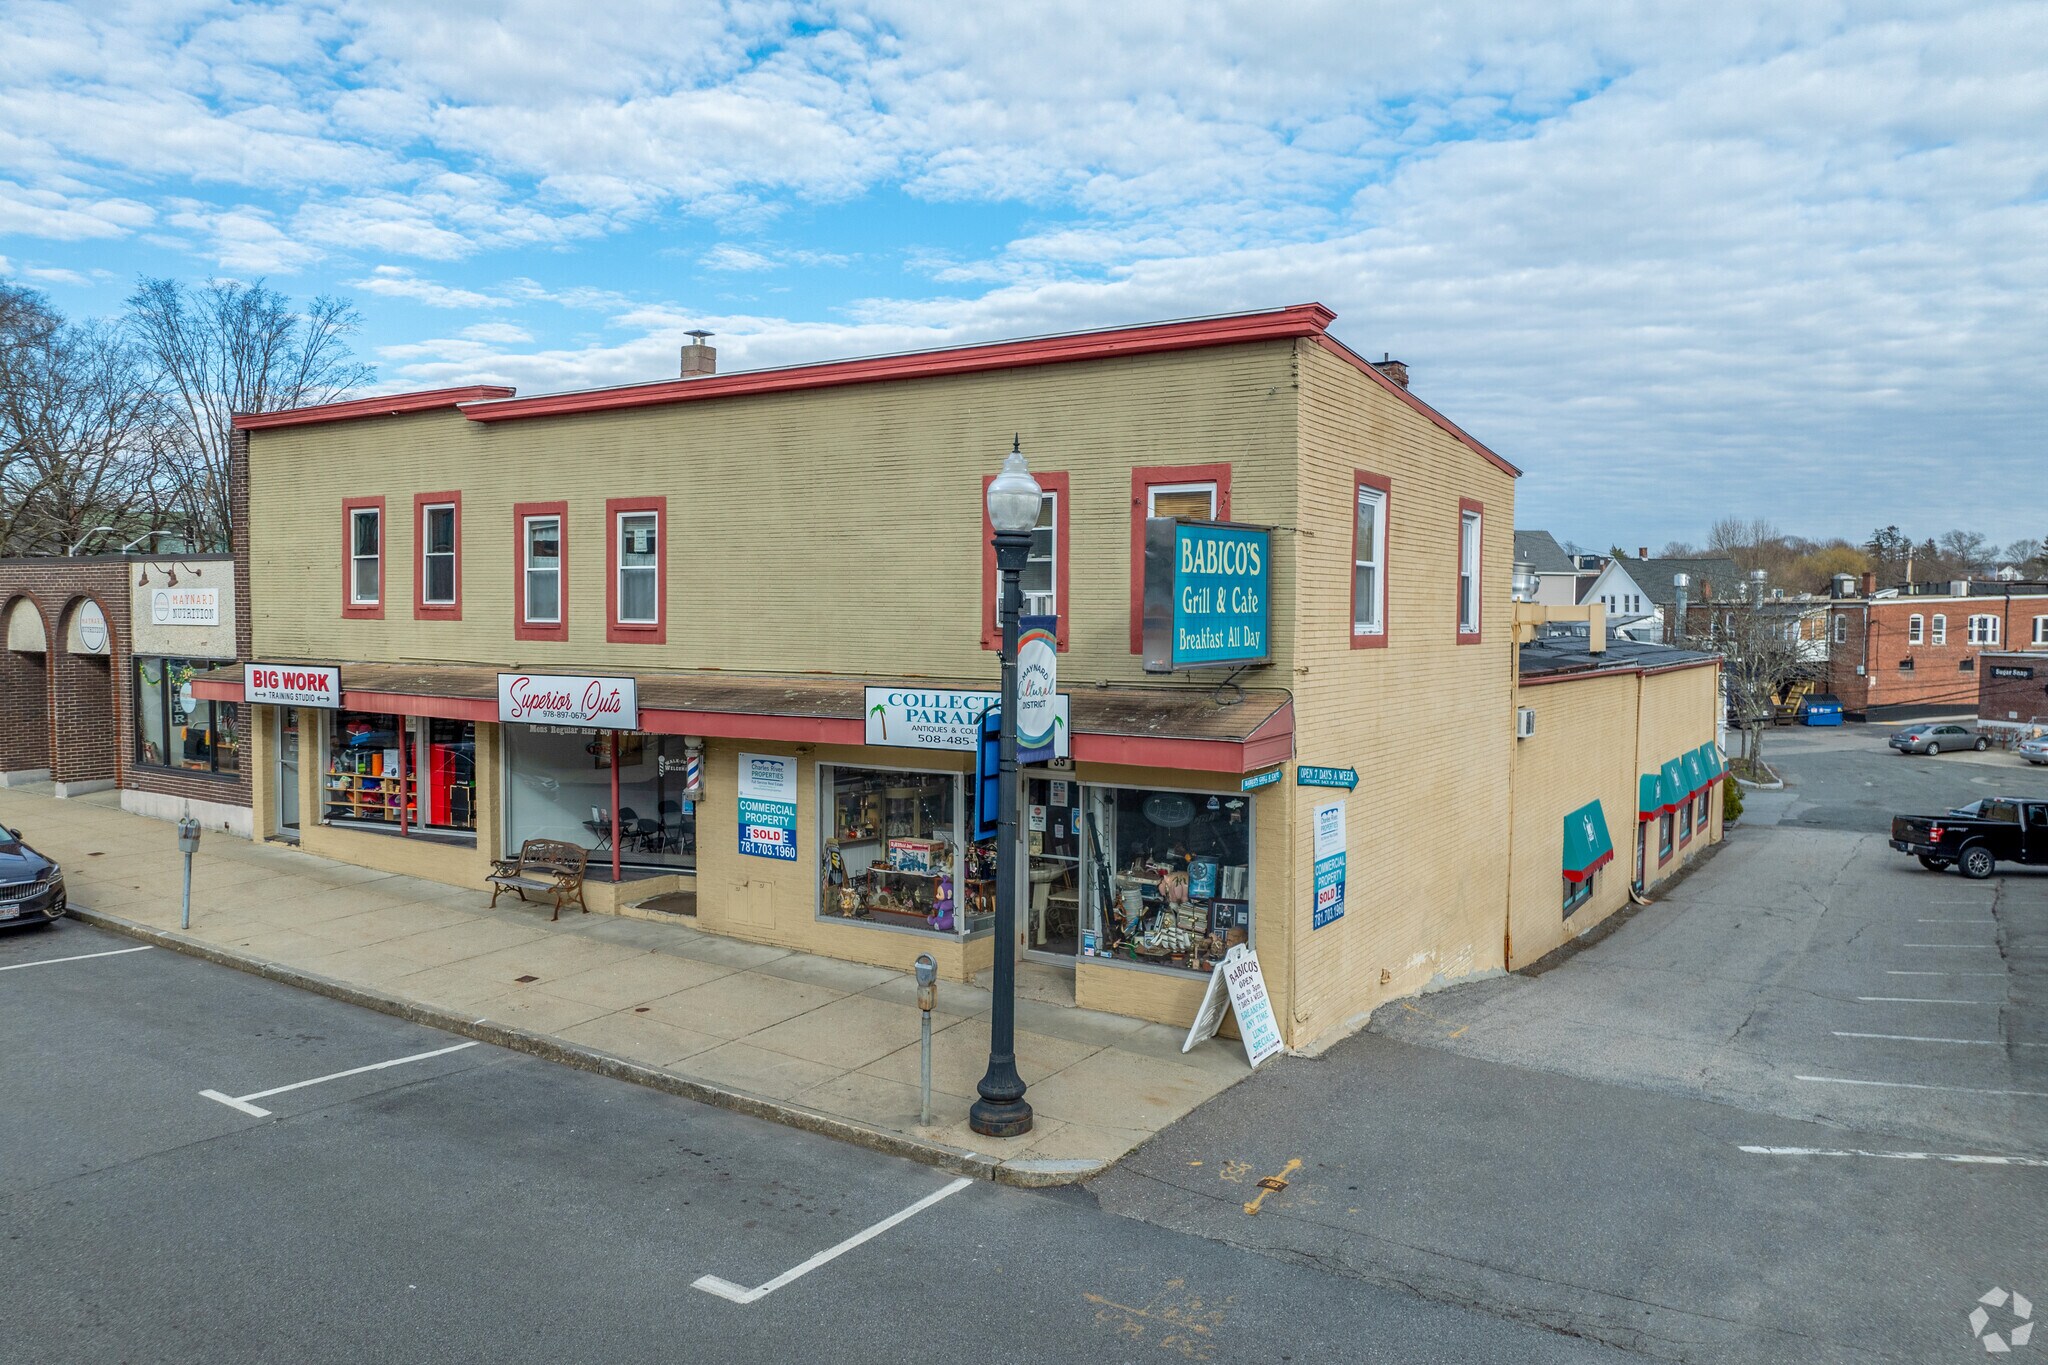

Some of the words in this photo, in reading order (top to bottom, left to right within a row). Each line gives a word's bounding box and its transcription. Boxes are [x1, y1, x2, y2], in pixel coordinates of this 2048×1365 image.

[1181, 538, 1261, 576] BABICO'S
[172, 594, 214, 605] MAYNARD
[1182, 586, 1210, 614] Grill
[1216, 586, 1227, 614] &
[1232, 586, 1259, 614] Cafe
[172, 608, 214, 620] NUTRITION
[1179, 627, 1224, 650] Breakfast
[1227, 626, 1240, 648] All
[1243, 625, 1260, 650] Day
[1021, 663, 1049, 681] MAYNARD
[253, 670, 279, 689] BIG
[282, 672, 330, 692] WORK
[268, 691, 294, 700] TRAINING
[295, 693, 316, 702] STUDIO
[510, 677, 573, 718] Superior
[1022, 700, 1047, 709] DISTRICT
[542, 710, 588, 720] 978-897-0679
[550, 725, 578, 736] Regular
[911, 725, 948, 733] ANTIQUES
[752, 771, 784, 780] PROPERTIES
[1300, 768, 1313, 778] OPEN
[1319, 769, 1332, 780] DAYS
[1333, 770, 1338, 781] A
[1339, 771, 1353, 782] WEEK
[740, 800, 795, 816] COMMERCIAL
[745, 812, 789, 826] PROPERTY
[753, 829, 781, 841] SOLD
[741, 841, 796, 858] 781.703.1960
[1315, 856, 1345, 876] COMMERCIAL
[1318, 869, 1342, 889] PROPERTY
[1319, 888, 1335, 905] SOLD
[1229, 960, 1258, 985] BABICO'S
[1238, 975, 1254, 989] OPEN
[1241, 999, 1268, 1021] BREAKFAST
[1245, 1018, 1256, 1031] ANY
[1252, 1031, 1276, 1053] SPECIALS
